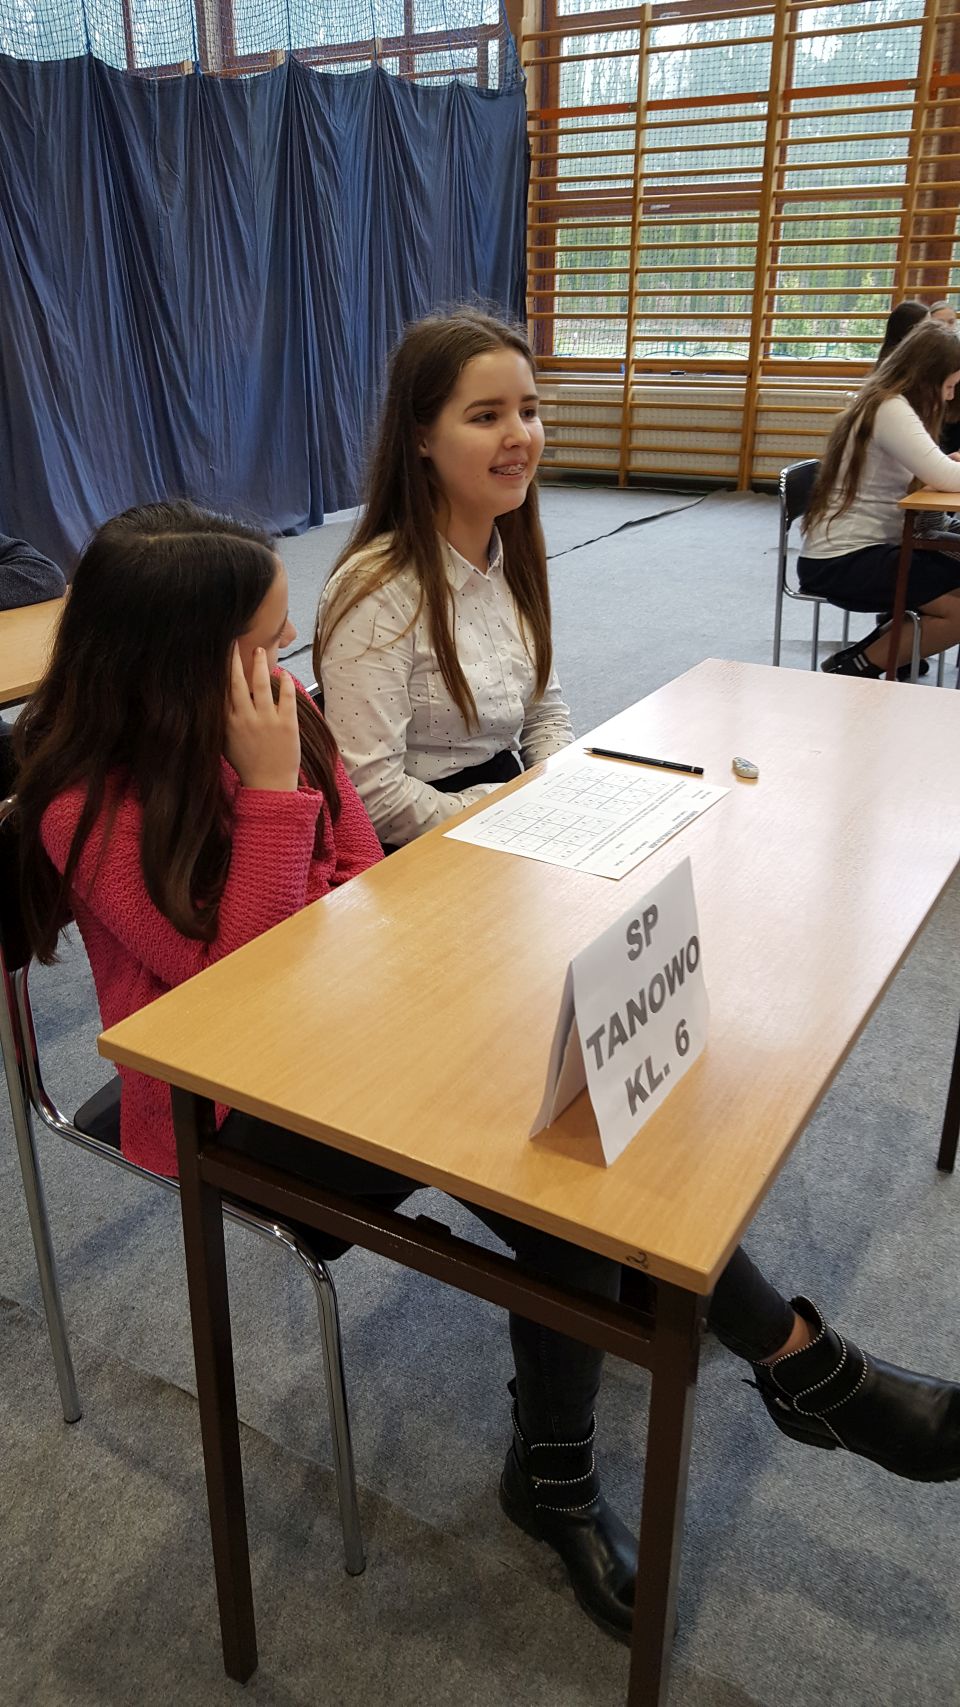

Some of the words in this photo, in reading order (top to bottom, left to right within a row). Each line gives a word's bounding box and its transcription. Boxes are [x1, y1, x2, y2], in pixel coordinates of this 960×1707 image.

[626, 903, 659, 962] SP
[586, 935, 700, 1071] TANOWO
[624, 1055, 671, 1117] KL.
[674, 1018, 690, 1057] 6
